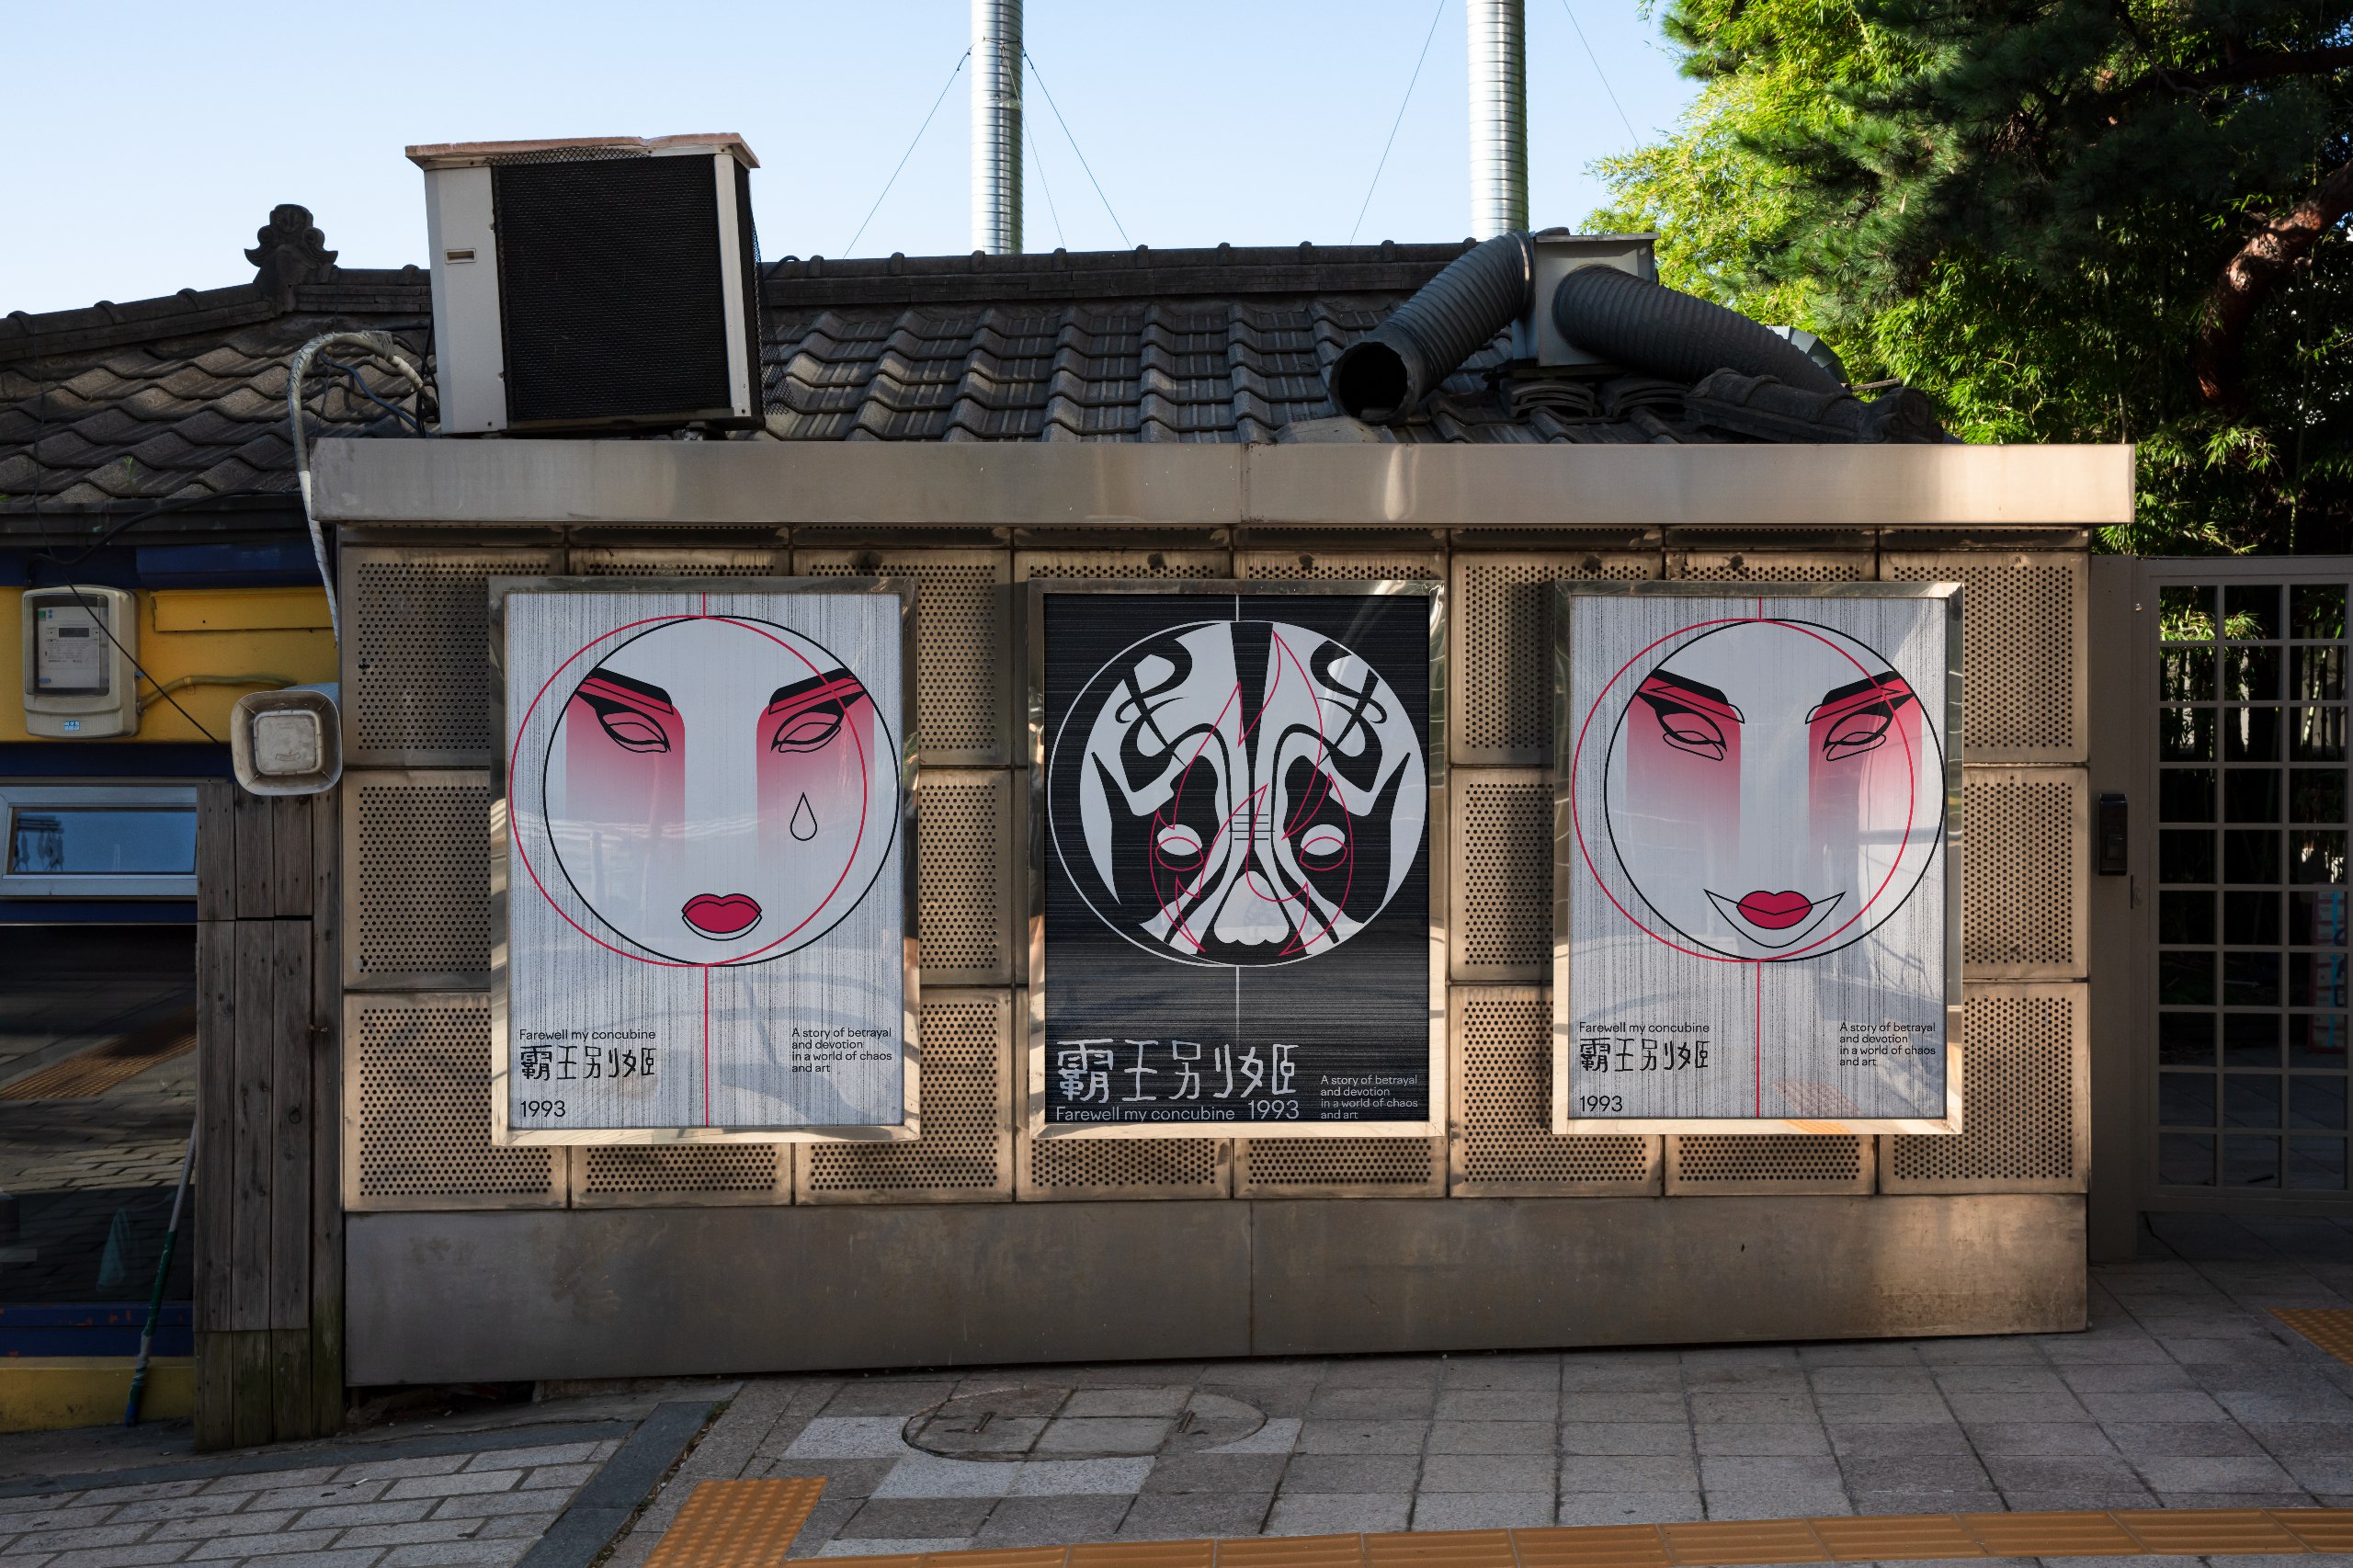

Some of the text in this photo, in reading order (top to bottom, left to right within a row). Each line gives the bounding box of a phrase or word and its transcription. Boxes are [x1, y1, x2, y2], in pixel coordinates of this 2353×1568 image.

[1579, 1021, 1710, 1035] Farewell my concubine
[1839, 1022, 1936, 1034] A story of betrayal
[519, 1028, 656, 1042] Farewell my concubine
[791, 1028, 892, 1040] A story of betrayal
[1839, 1034, 1907, 1043] and devotion
[791, 1040, 863, 1049] and devotion
[1840, 1045, 1849, 1055] in
[1860, 1045, 1888, 1054] world
[1891, 1045, 1902, 1054] of
[1904, 1045, 1936, 1054] chaos
[792, 1051, 801, 1061] in
[813, 1051, 843, 1061] world
[846, 1051, 858, 1061] of
[859, 1051, 892, 1061] chaos
[1839, 1057, 1859, 1066] and
[791, 1063, 831, 1073] and art
[1321, 1074, 1417, 1086] A story of betrayal
[1321, 1086, 1390, 1096] and devotion
[1321, 1098, 1330, 1108] in
[1341, 1097, 1370, 1108] world
[1372, 1097, 1384, 1108] of
[1386, 1097, 1418, 1108] chaos
[1579, 1095, 1622, 1112] 1993
[520, 1100, 566, 1118] 1993
[1056, 1099, 1300, 1122] Farewell my concubine 1993
[1321, 1109, 1358, 1119] and art
